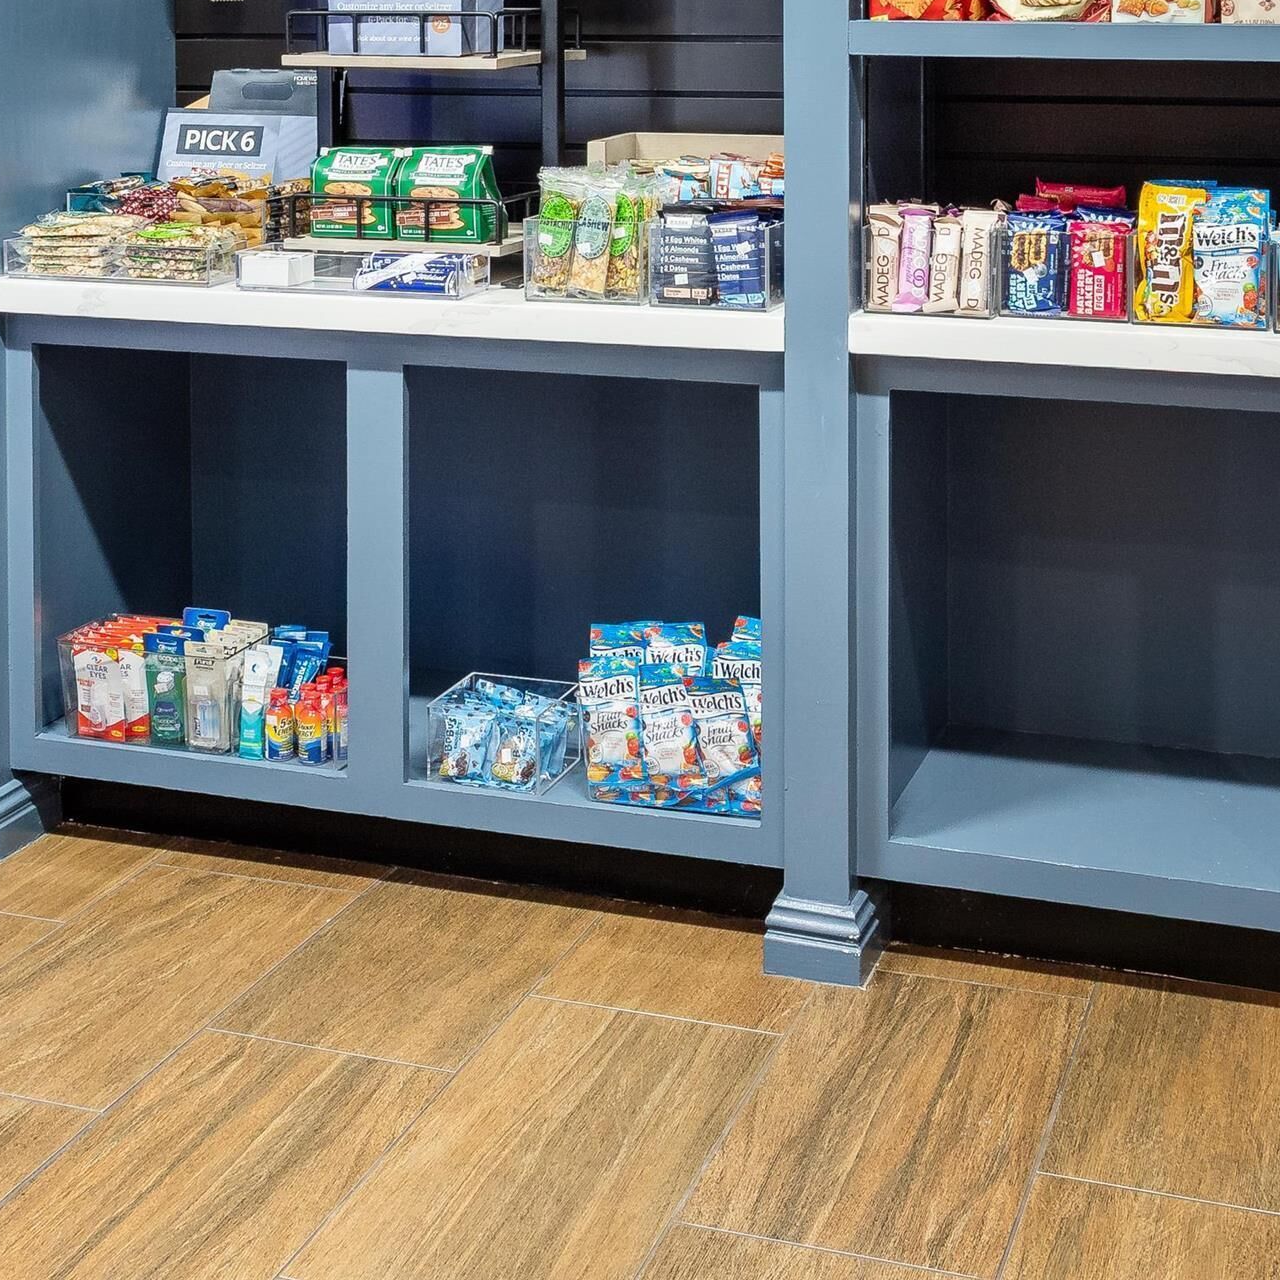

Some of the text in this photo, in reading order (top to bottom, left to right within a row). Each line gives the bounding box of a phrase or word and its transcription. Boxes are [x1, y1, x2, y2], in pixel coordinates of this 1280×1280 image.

[336, 3, 378, 11] Customize
[184, 129, 255, 152] PICK 6
[340, 155, 376, 165] TATE'S
[425, 157, 464, 168] TATE'S
[578, 216, 609, 231] CASHEW
[1196, 227, 1256, 247] Welch's
[86, 664, 108, 674] CLEAR
[89, 672, 107, 680] EYES
[583, 679, 633, 698] Welch's
[692, 694, 742, 711] Welch's
